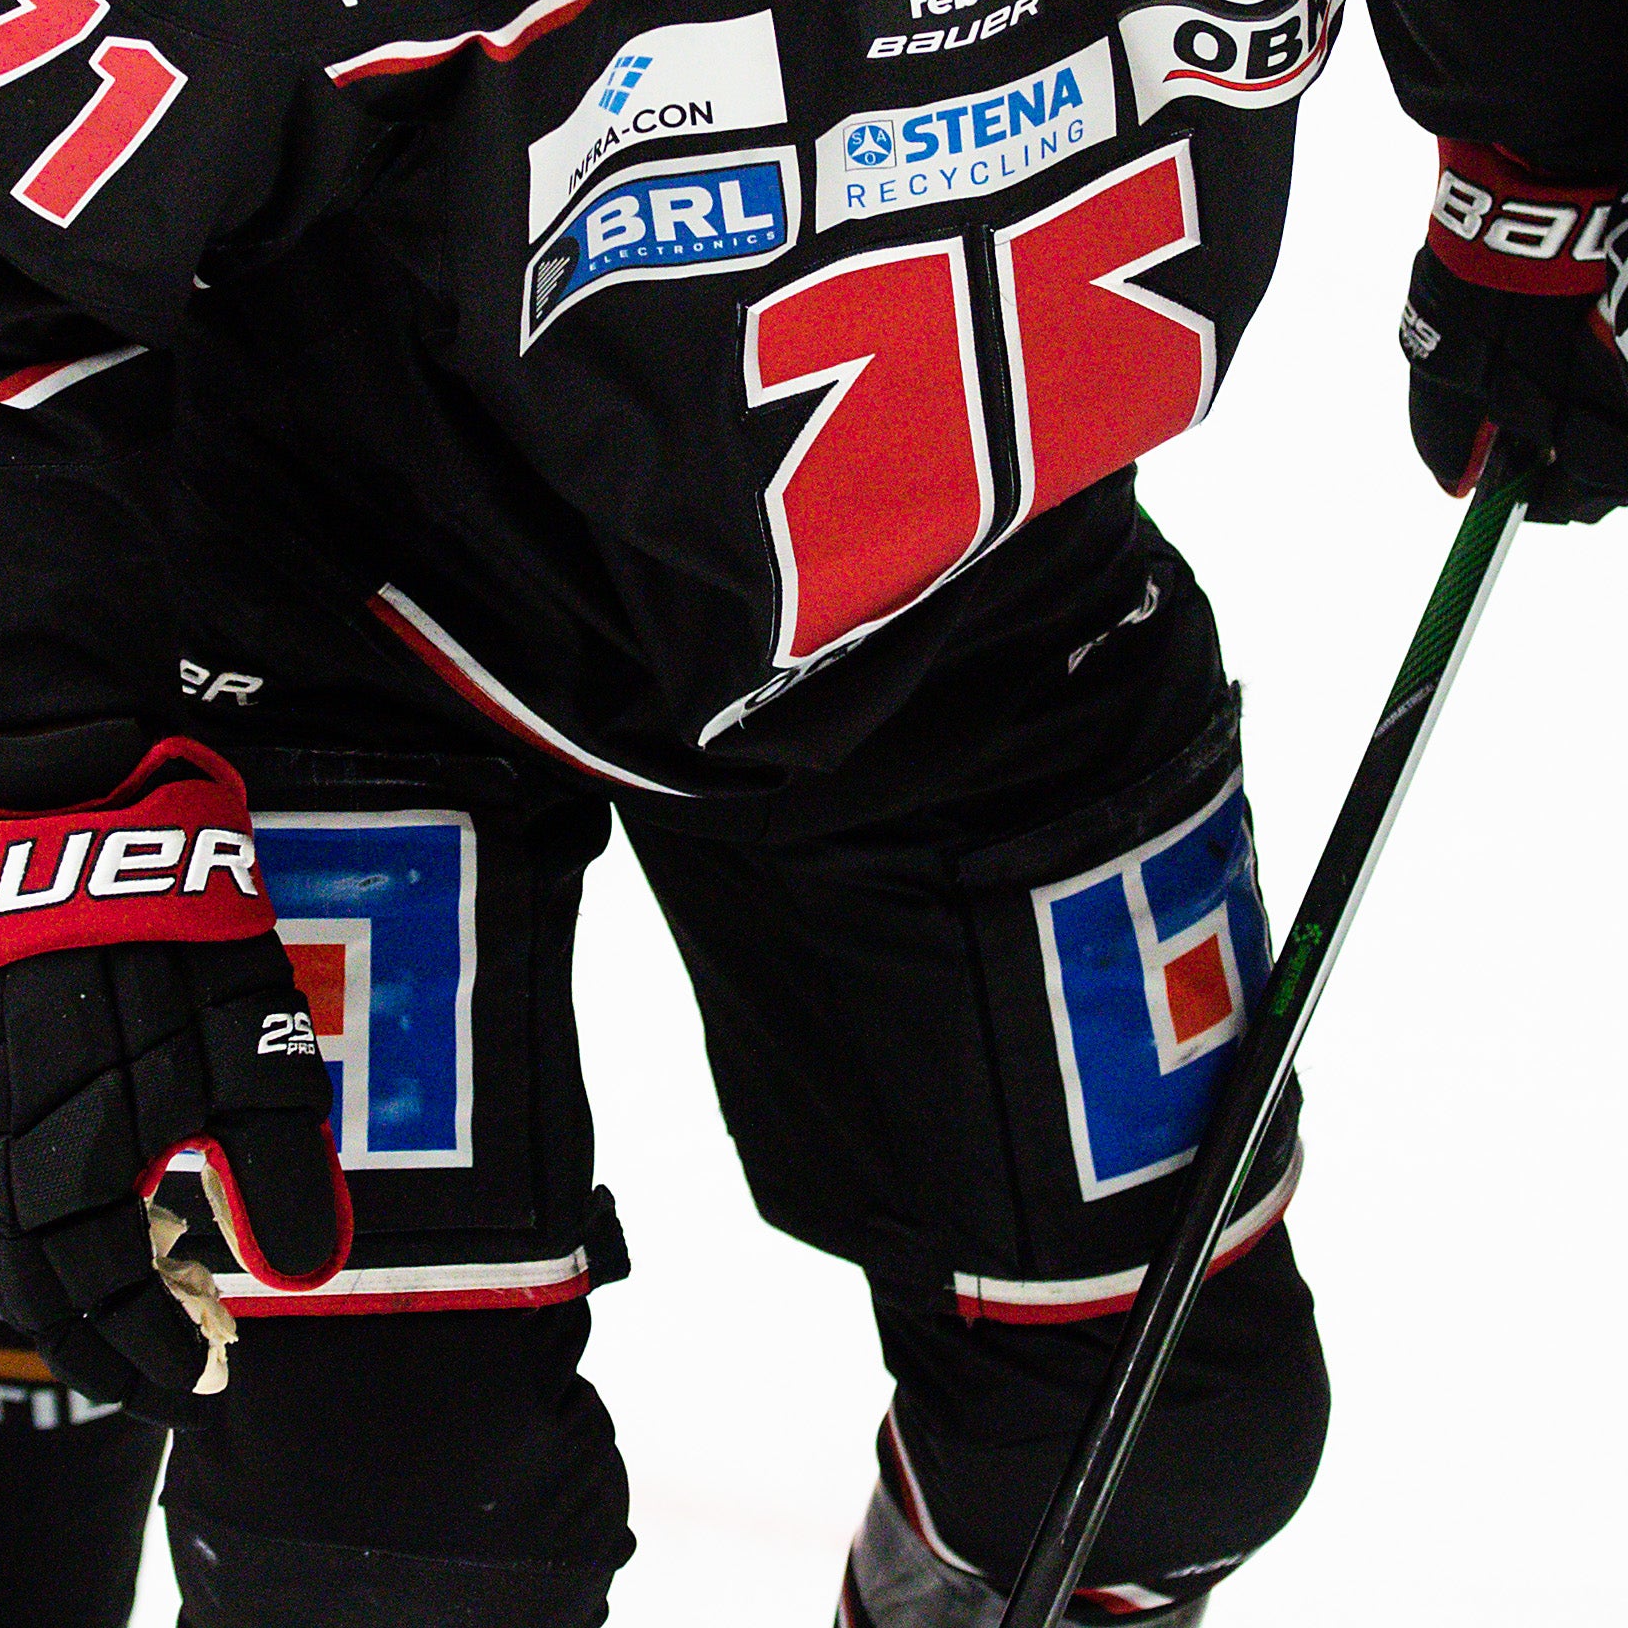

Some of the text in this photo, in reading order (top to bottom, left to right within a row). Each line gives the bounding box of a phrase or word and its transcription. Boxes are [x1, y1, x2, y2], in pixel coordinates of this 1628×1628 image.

[567, 99, 715, 196] INFRA-CON
[903, 66, 1085, 165] STENA
[847, 118, 1085, 209] RECYCLING
[584, 178, 775, 261] BRL
[588, 230, 776, 274] ELECTRONICS
[1431, 168, 1611, 262] BAU
